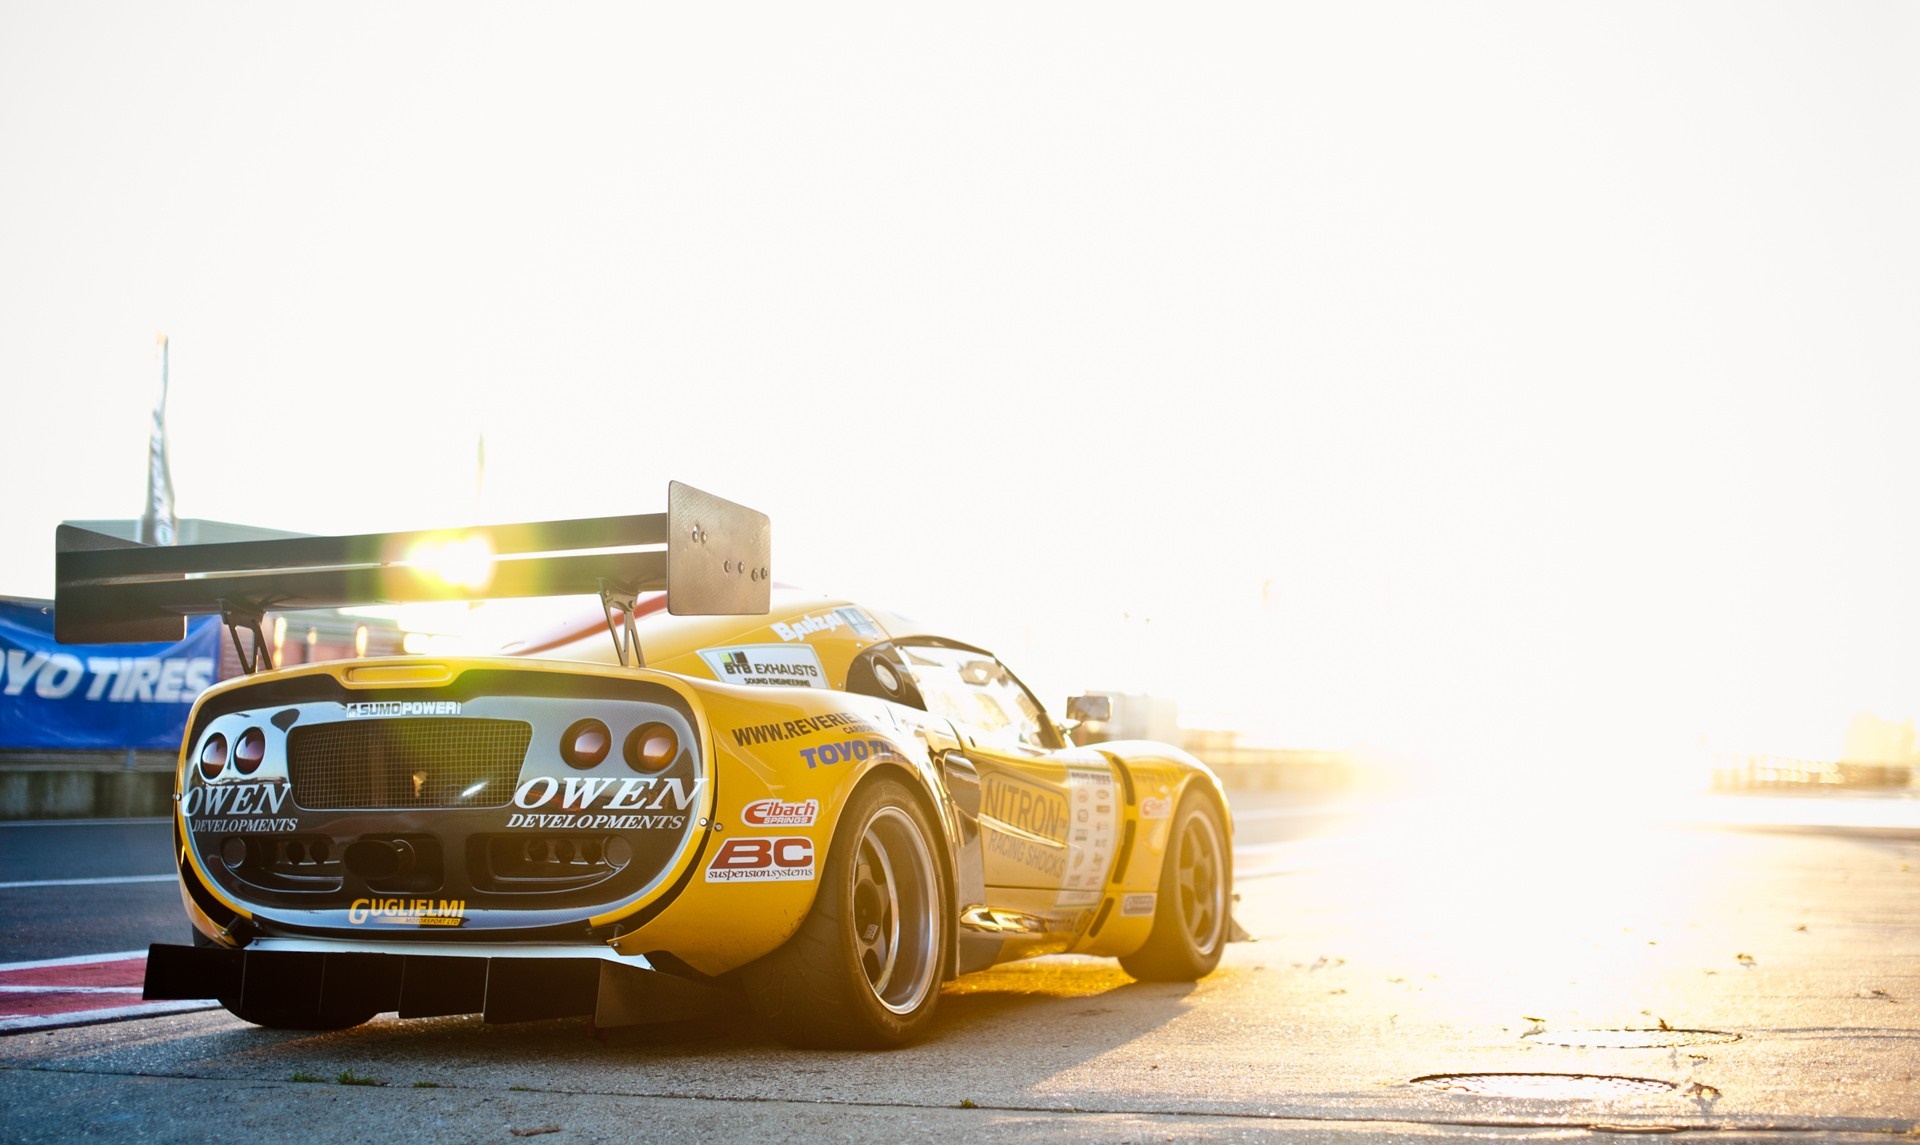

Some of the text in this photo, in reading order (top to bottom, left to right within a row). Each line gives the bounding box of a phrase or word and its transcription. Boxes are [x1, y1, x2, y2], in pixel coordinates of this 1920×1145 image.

[86, 656, 216, 703] TIRES
[724, 663, 818, 677] BTB EXHAUSTS
[744, 677, 811, 687] SOUND ENGINEERING
[799, 740, 869, 769] TOYO
[182, 783, 291, 817] OWEN
[514, 776, 709, 810] OWEN
[506, 813, 686, 830] DEVELOPMENTS
[744, 801, 815, 825] Eibach
[763, 816, 808, 824] SPRINGS
[984, 778, 1061, 842] NITRON
[193, 818, 298, 833] DEVELOPMENTS
[709, 838, 813, 870] BC
[988, 831, 1066, 880] RACING SHOCKS
[348, 898, 465, 925] GUGLIELMI
[447, 918, 459, 926] LTD
